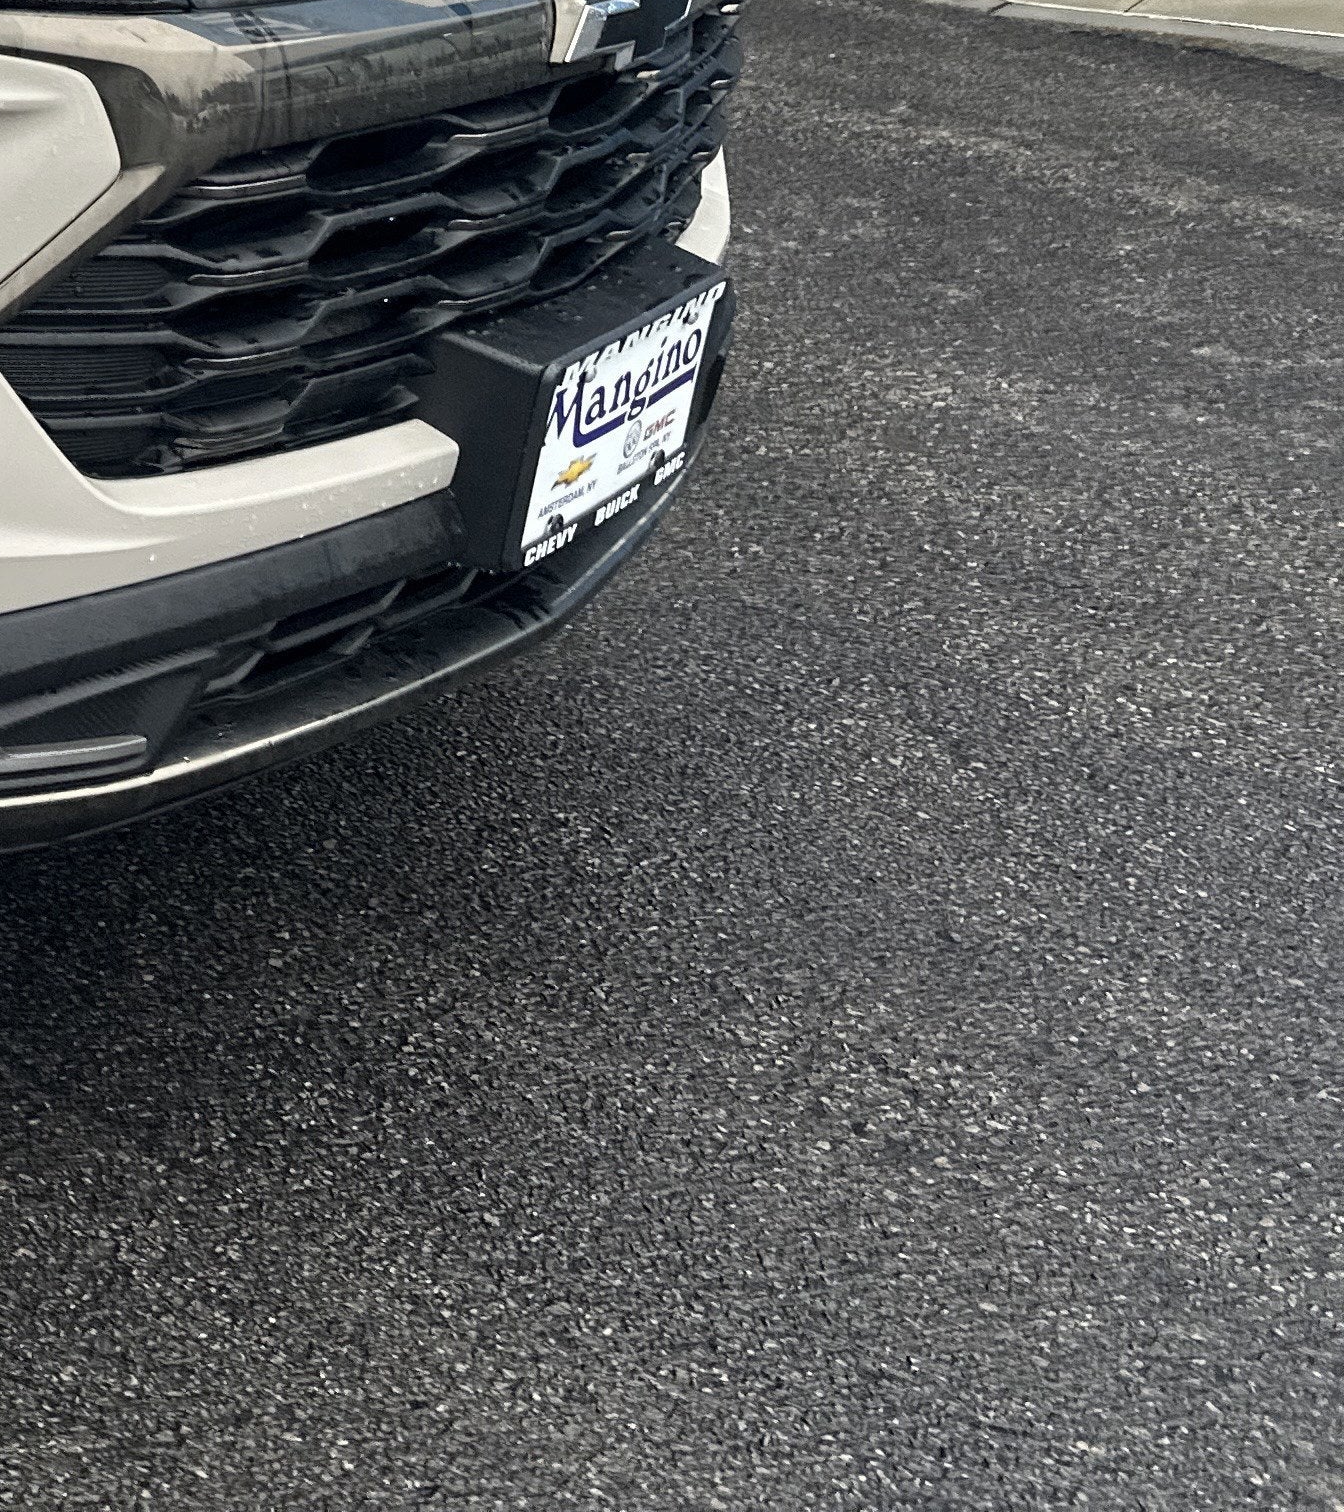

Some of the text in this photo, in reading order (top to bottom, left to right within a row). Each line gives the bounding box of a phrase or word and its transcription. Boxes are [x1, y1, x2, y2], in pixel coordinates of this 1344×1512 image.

[545, 328, 702, 448] Mangino
[643, 408, 676, 441] GMC
[524, 451, 686, 567] CHEVY BUICK GMC
